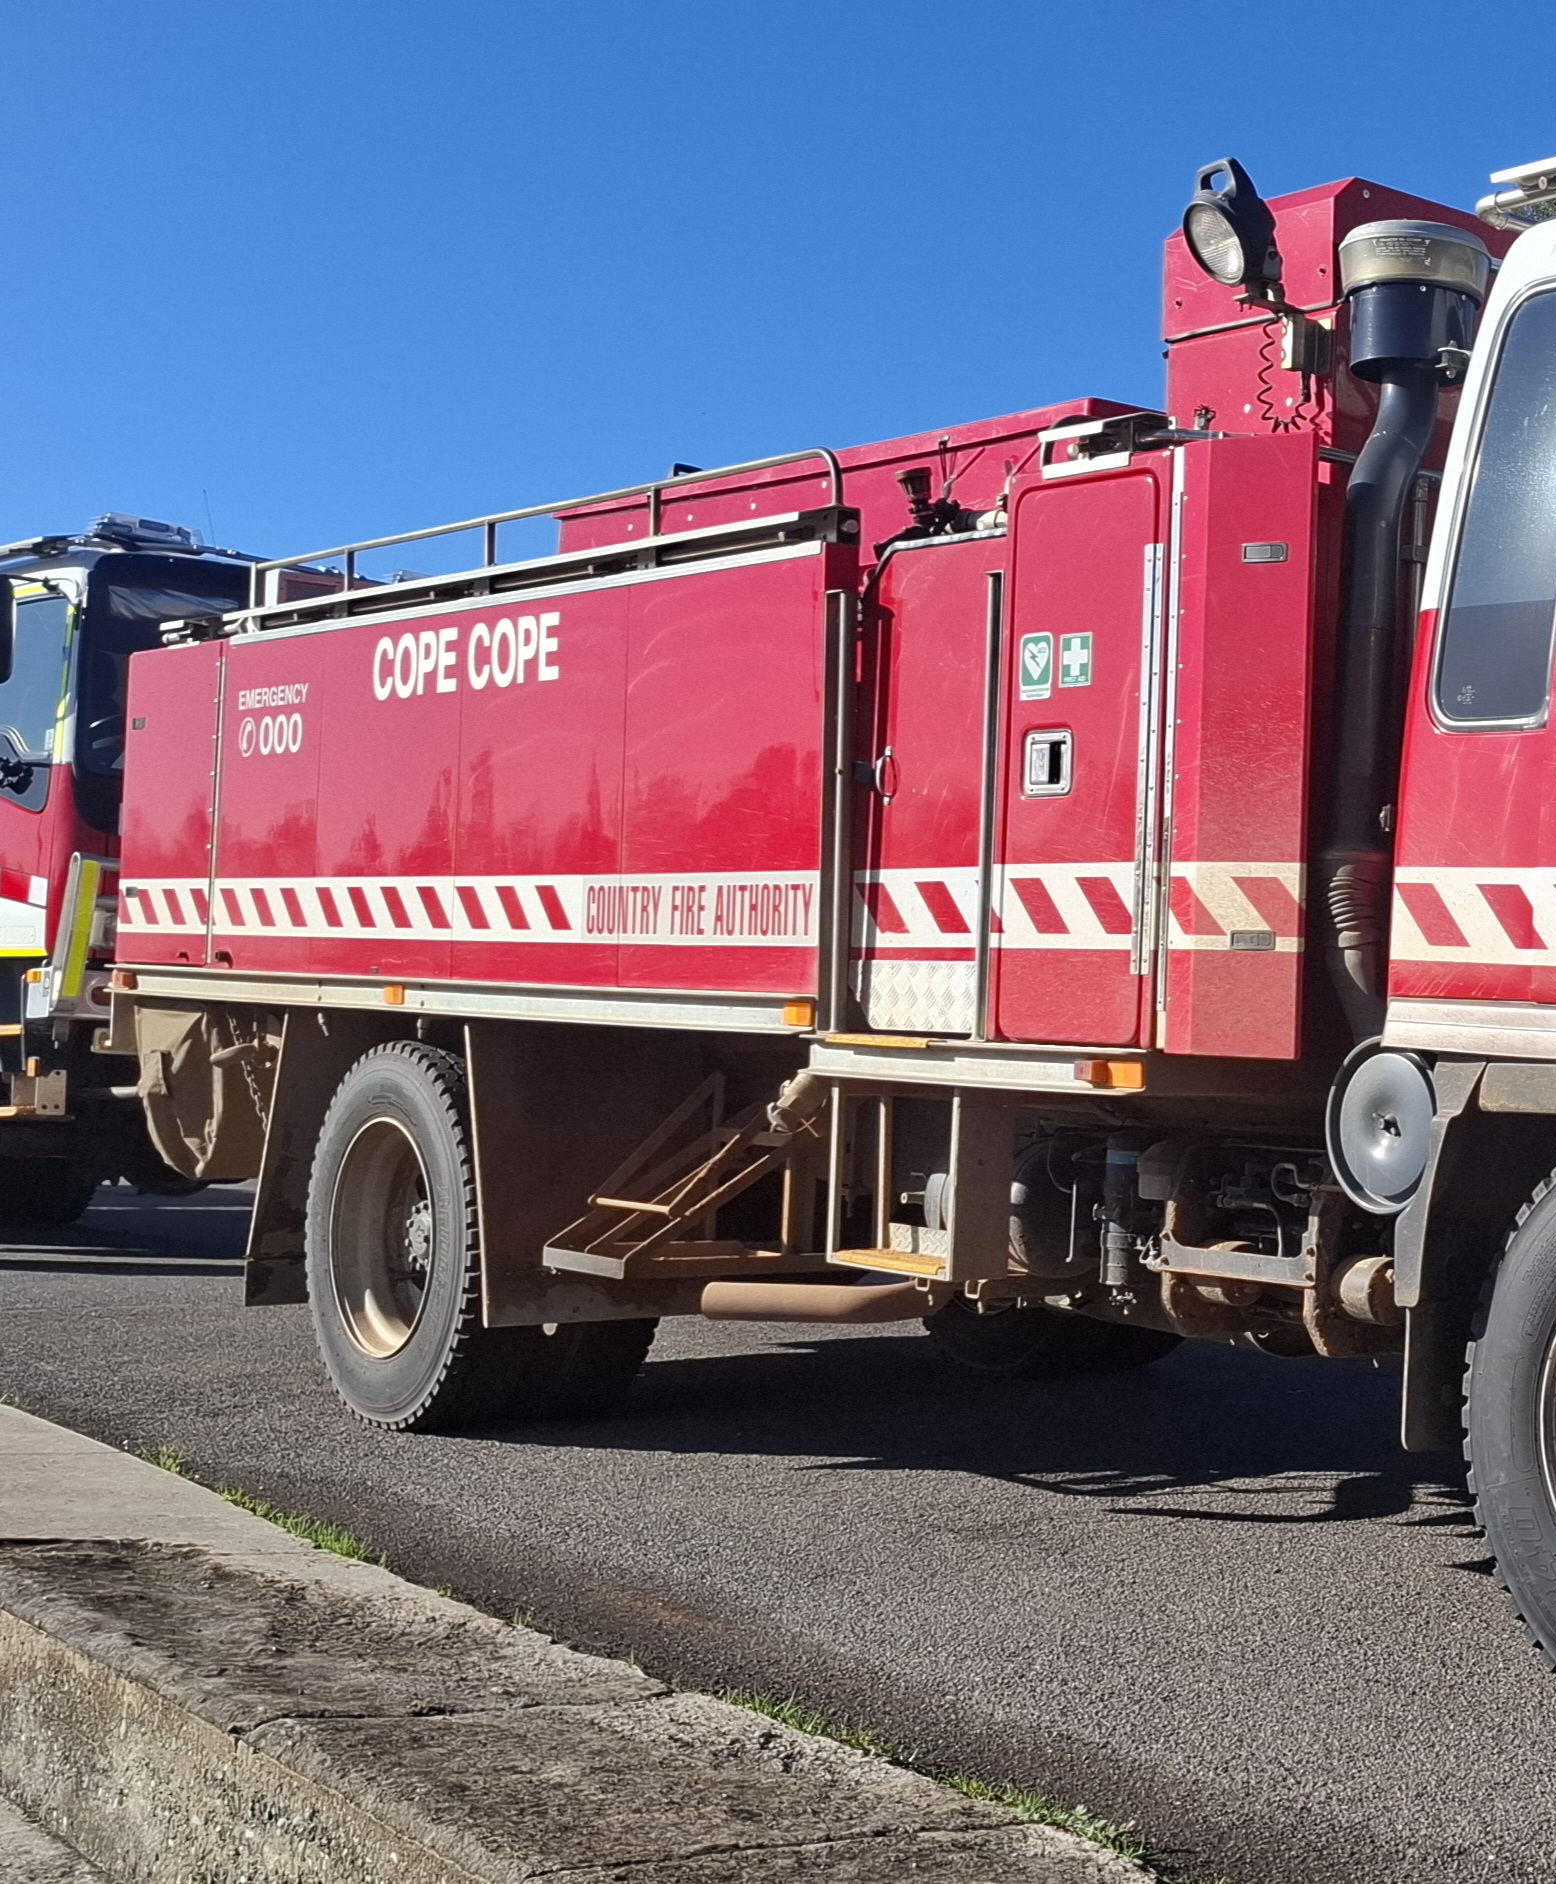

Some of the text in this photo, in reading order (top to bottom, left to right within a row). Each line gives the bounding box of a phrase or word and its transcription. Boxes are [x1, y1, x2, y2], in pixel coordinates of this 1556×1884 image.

[373, 612, 560, 701] COPE COPE
[238, 683, 309, 710] EMERGENCY
[259, 713, 302, 755] 000
[586, 883, 814, 936] COUNTRY FIRE AUTHORITY
